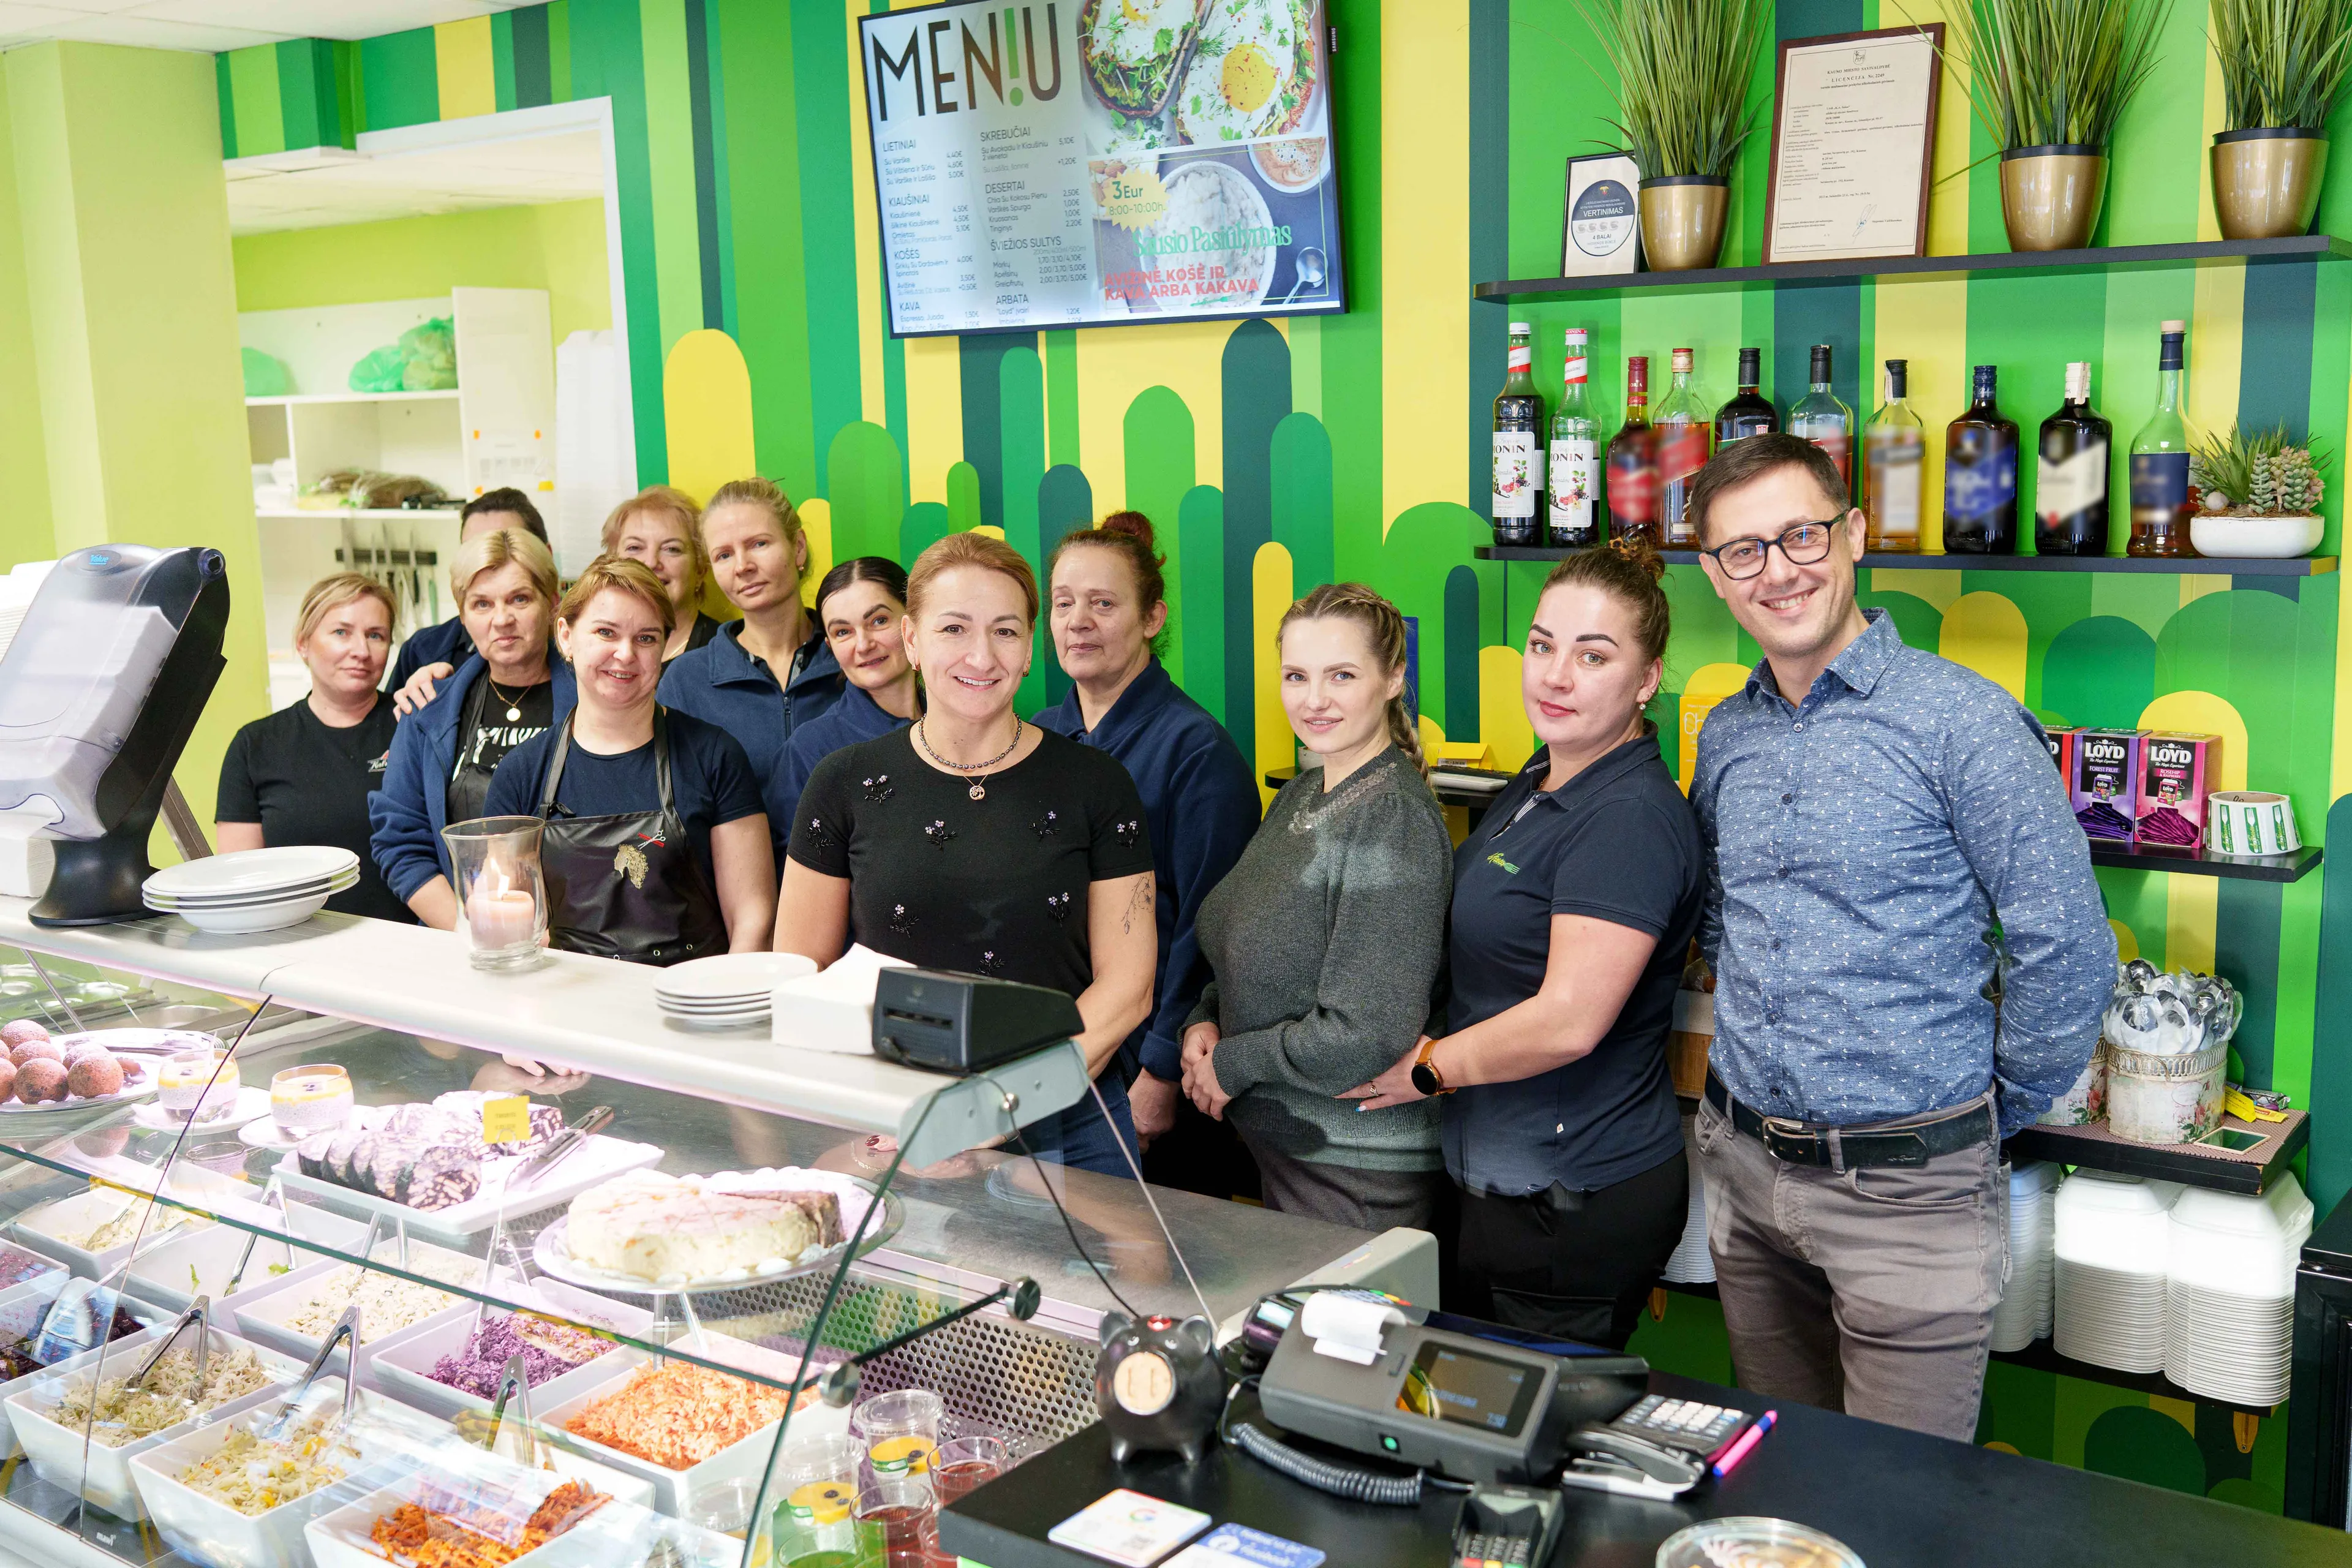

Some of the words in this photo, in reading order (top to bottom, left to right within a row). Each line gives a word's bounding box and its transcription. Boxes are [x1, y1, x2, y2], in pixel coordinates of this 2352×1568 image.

[980, 126, 1031, 142] SKREBUČIAI
[1058, 137, 1074, 145] 5,10€
[985, 181, 1025, 194] DESERTAI
[1063, 189, 1079, 197] 2,50€
[1112, 181, 1123, 200] 3
[1125, 186, 1144, 198] Eur
[889, 194, 930, 207] KIAUŠINIAI
[1063, 198, 1080, 207] 1,00€
[1583, 207, 1623, 217] VERTINIMAS
[990, 238, 1028, 251] ŠVIEŽIOS
[1030, 236, 1061, 247] SULTYS
[1133, 230, 1188, 257] Sausio
[1191, 222, 1292, 256] Pasiūlymas
[894, 247, 920, 260] KOŠĖS
[1104, 265, 1163, 287] AVIŽINĖ
[1166, 262, 1204, 282] KOŠĖ
[1210, 265, 1225, 279] IR
[1105, 286, 1146, 301] KAVA
[1148, 283, 1191, 298] ARBA
[1196, 278, 1259, 295] KAKAVA
[900, 301, 921, 311] KAVA
[996, 294, 1029, 305] ARBATA
[2085, 742, 2125, 760] LOYD
[2150, 746, 2192, 764] LOYD
